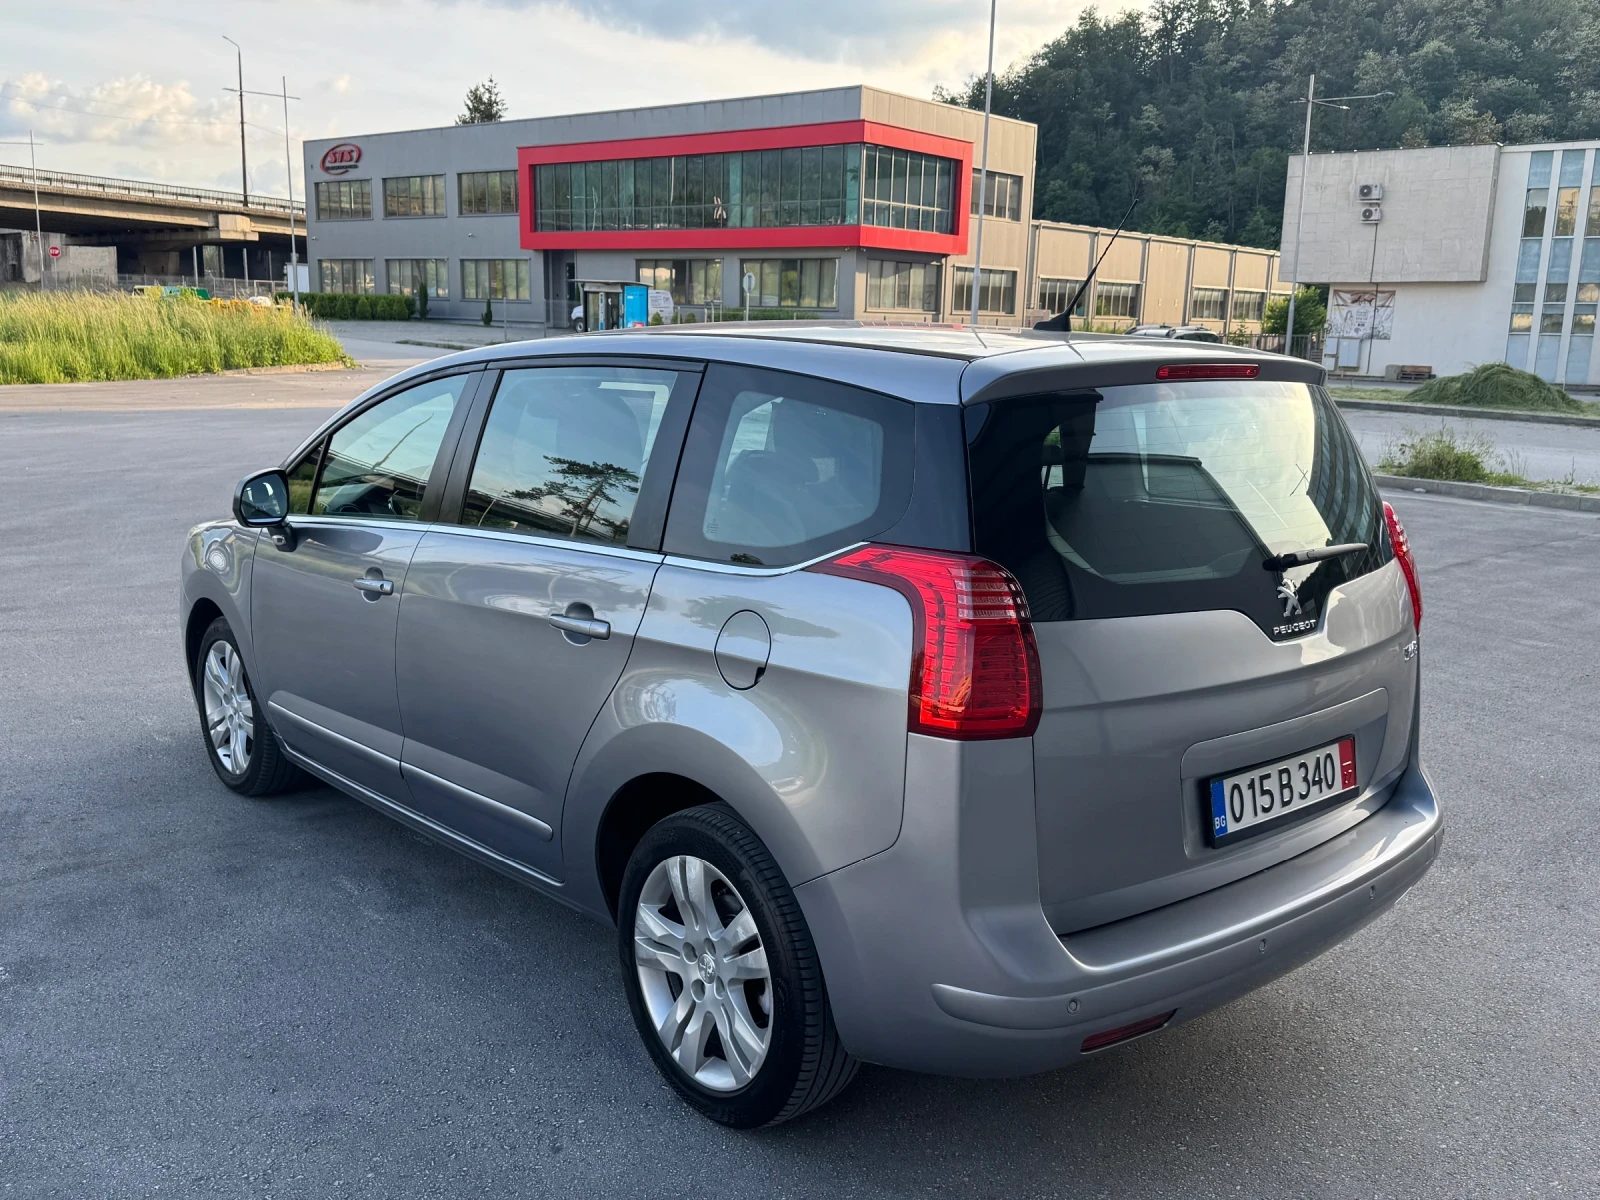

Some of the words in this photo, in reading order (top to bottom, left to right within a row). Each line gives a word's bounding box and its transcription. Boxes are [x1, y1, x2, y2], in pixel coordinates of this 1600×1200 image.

[328, 150, 354, 163] STS
[1273, 619, 1317, 636] PEUGEOT
[1214, 815, 1226, 830] BG
